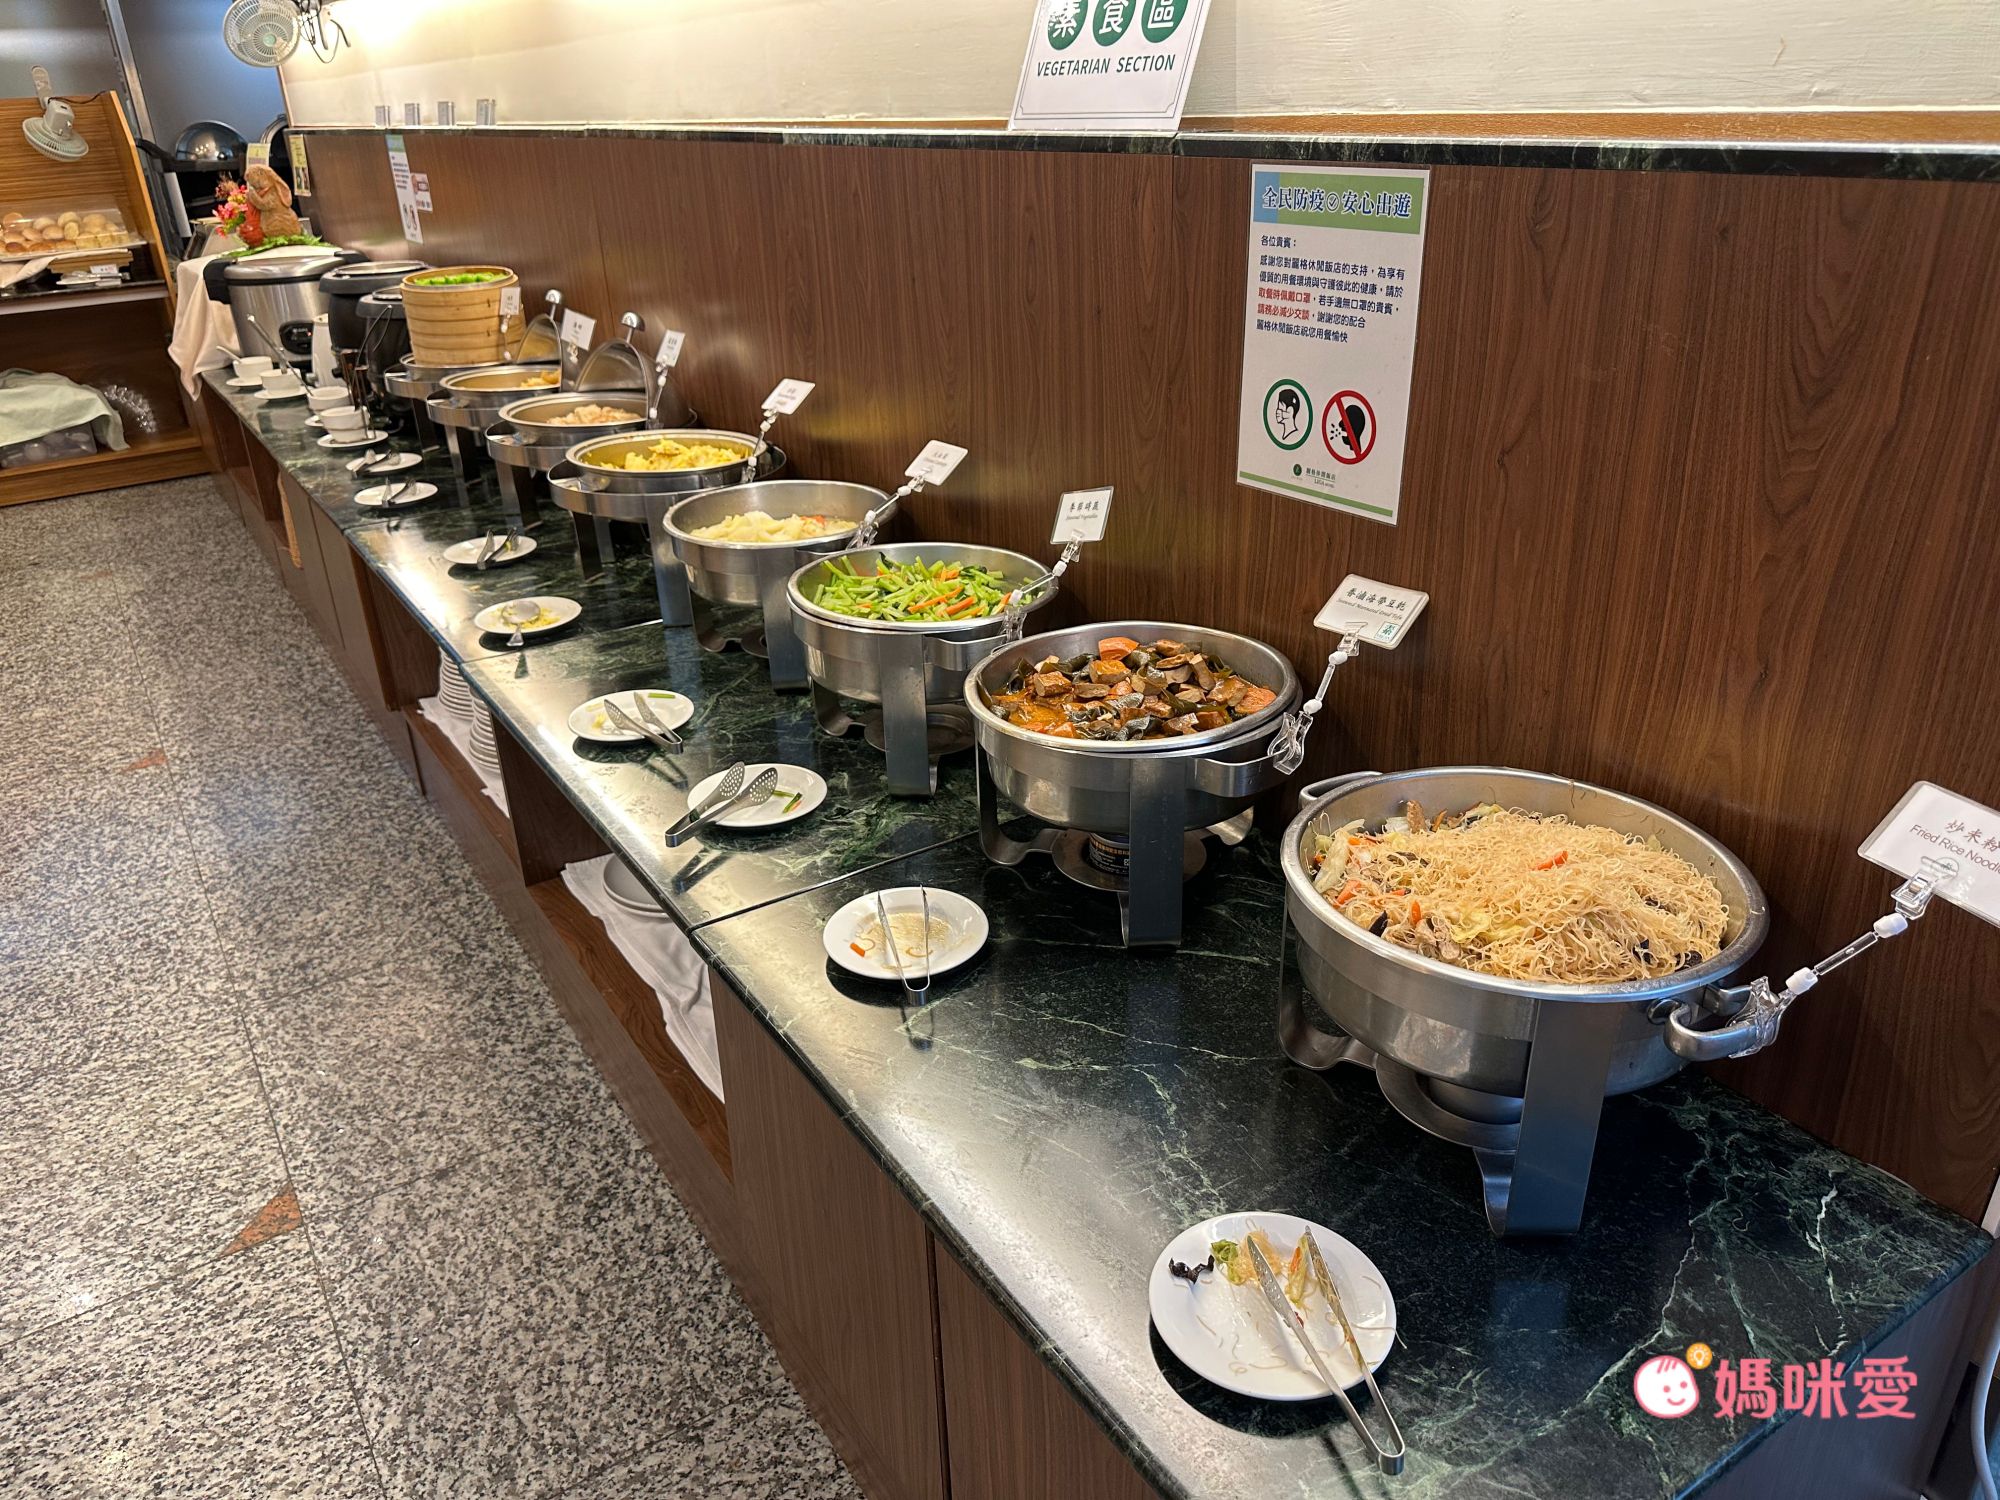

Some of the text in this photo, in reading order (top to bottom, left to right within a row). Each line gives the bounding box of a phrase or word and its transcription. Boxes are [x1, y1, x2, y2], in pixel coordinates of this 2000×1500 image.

[1037, 54, 1176, 77] VEGETARIAN SECTION
[1262, 186, 1412, 218] 全民防疫 安心出遊
[1909, 824, 1941, 843] Fried
[1937, 837, 1965, 856] Rice
